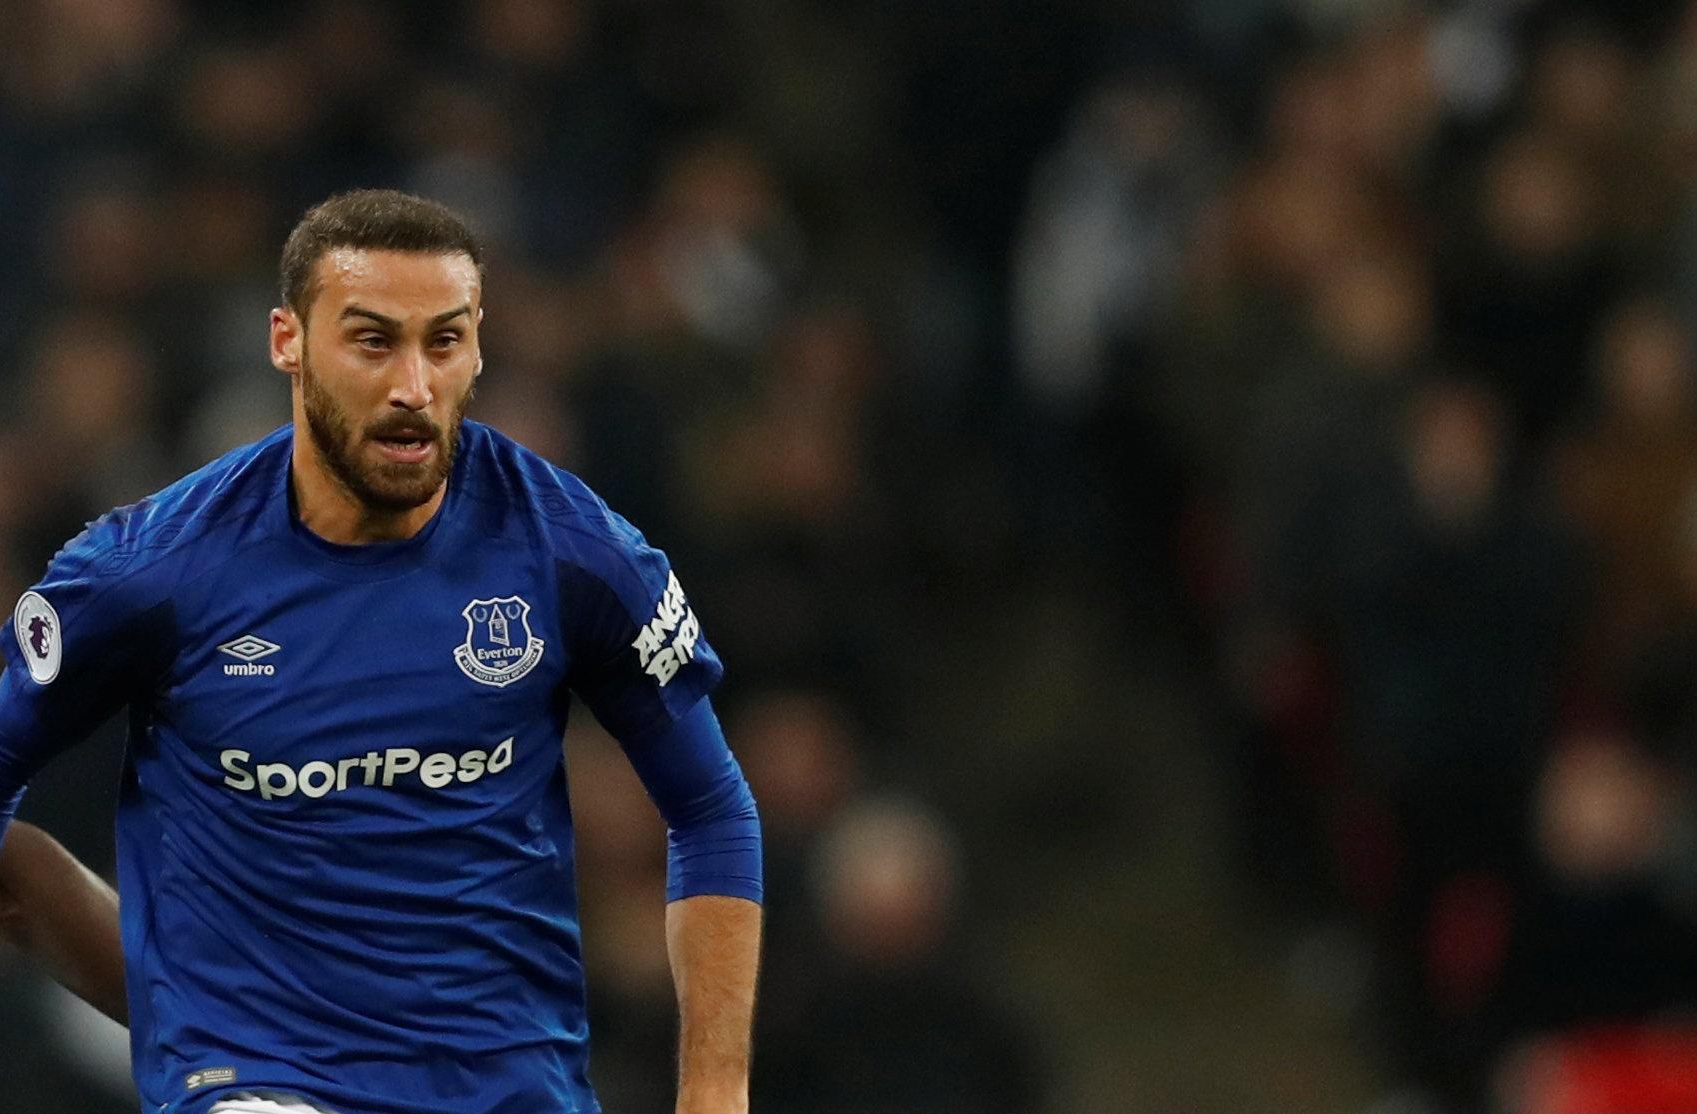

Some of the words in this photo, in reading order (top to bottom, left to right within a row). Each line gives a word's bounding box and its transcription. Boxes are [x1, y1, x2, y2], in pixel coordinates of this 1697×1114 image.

[631, 569, 686, 668] ANGR
[223, 662, 275, 676] umbro
[476, 646, 524, 661] Everton
[220, 736, 515, 801] SportPesa
